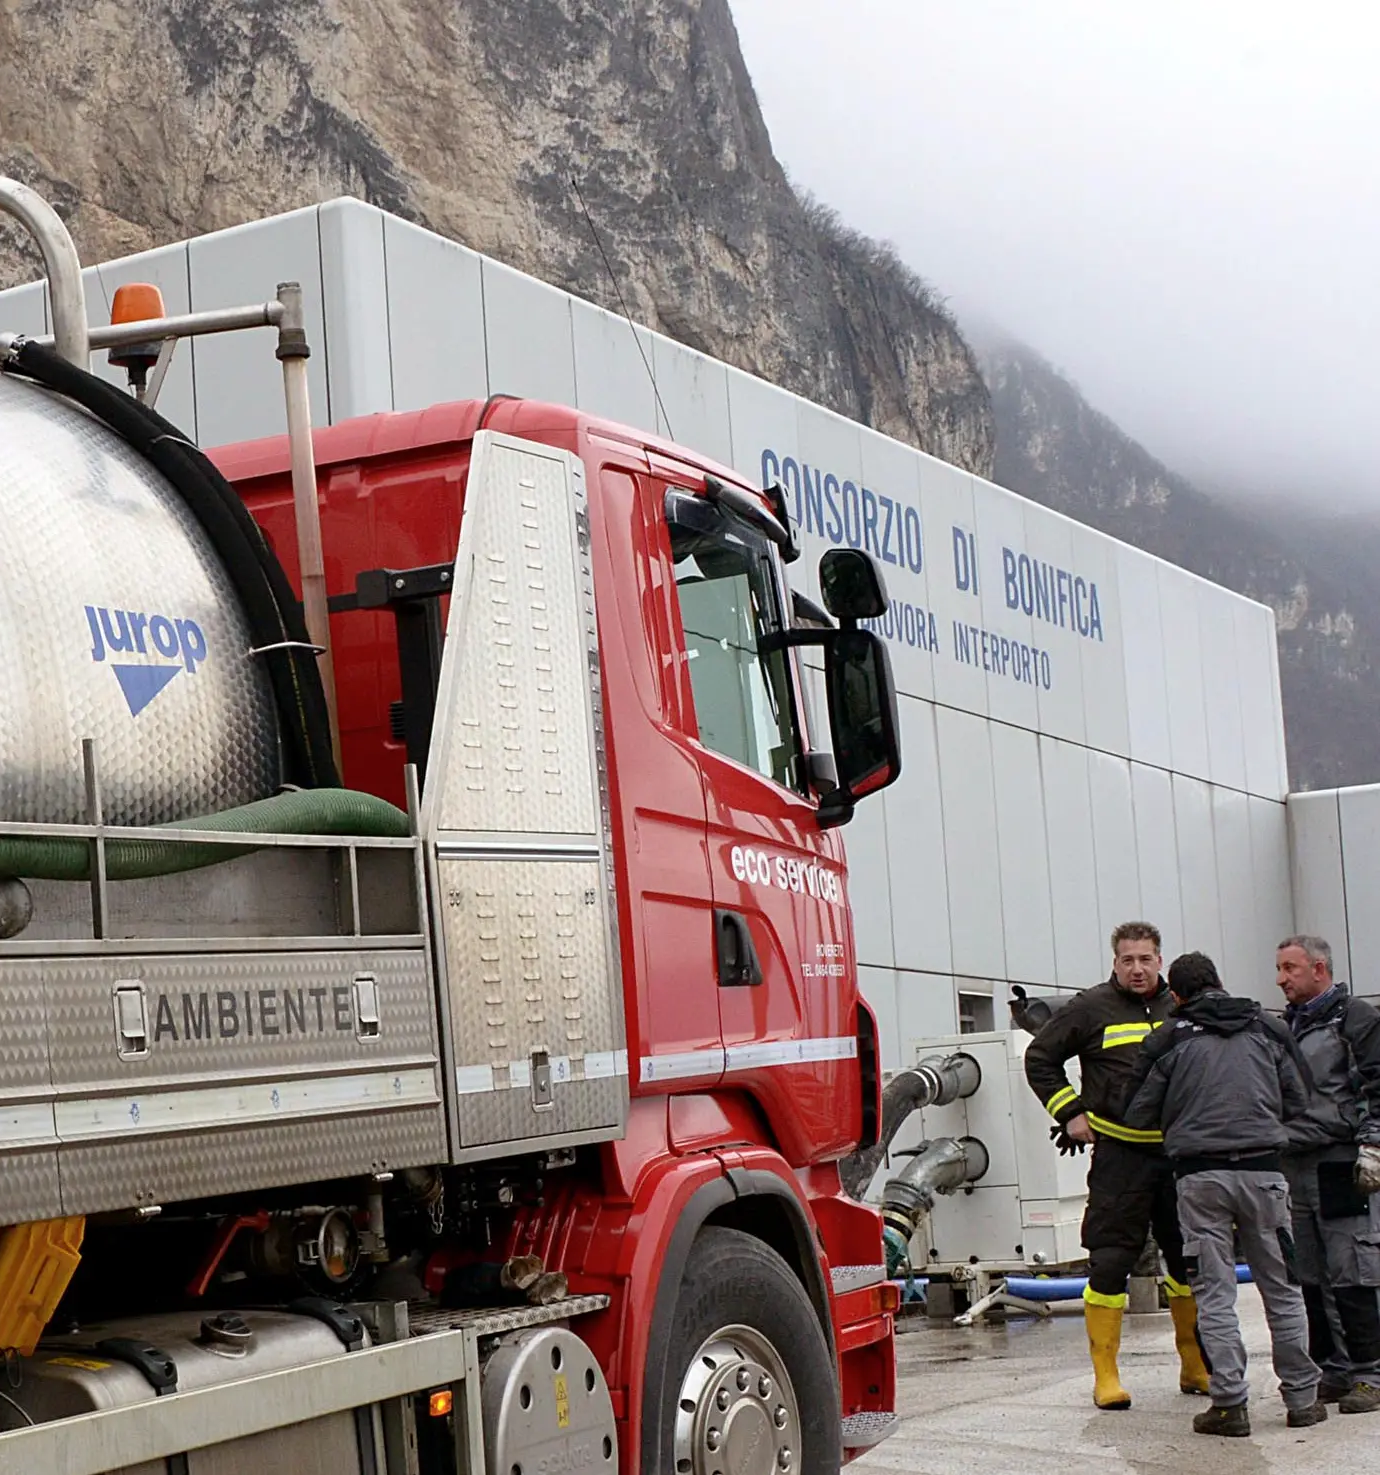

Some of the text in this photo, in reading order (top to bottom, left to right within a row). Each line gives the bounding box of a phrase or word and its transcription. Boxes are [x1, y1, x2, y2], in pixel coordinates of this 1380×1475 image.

[761, 449, 1104, 642] CONSORZIO DI BONIFICA
[952, 620, 1052, 690] INTERPORTO
[731, 845, 838, 903] eco service
[154, 986, 353, 1043] AMBIENTE
